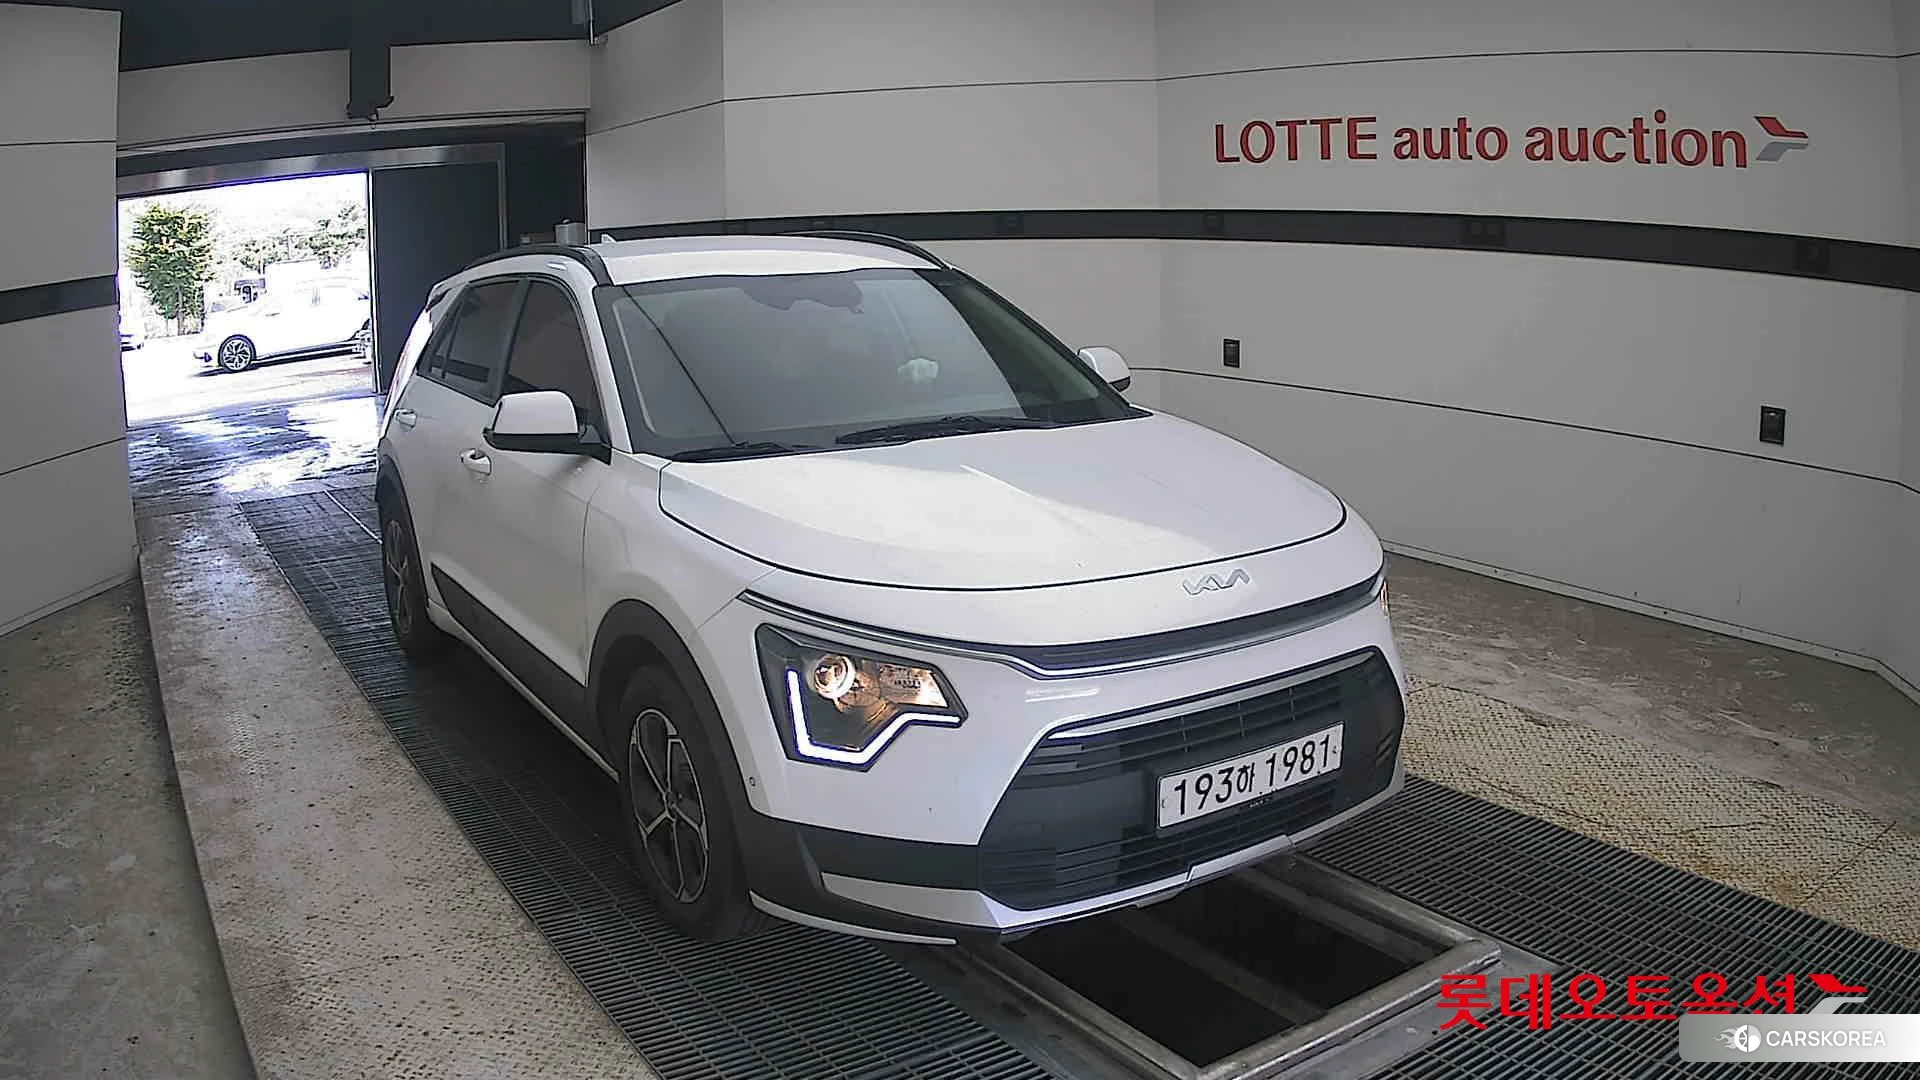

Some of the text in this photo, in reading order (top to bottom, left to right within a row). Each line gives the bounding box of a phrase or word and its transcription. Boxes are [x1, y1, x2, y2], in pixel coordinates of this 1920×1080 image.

[1214, 109, 1748, 168] LOTTE auto auction
[1174, 734, 1330, 815] 193하 1981
